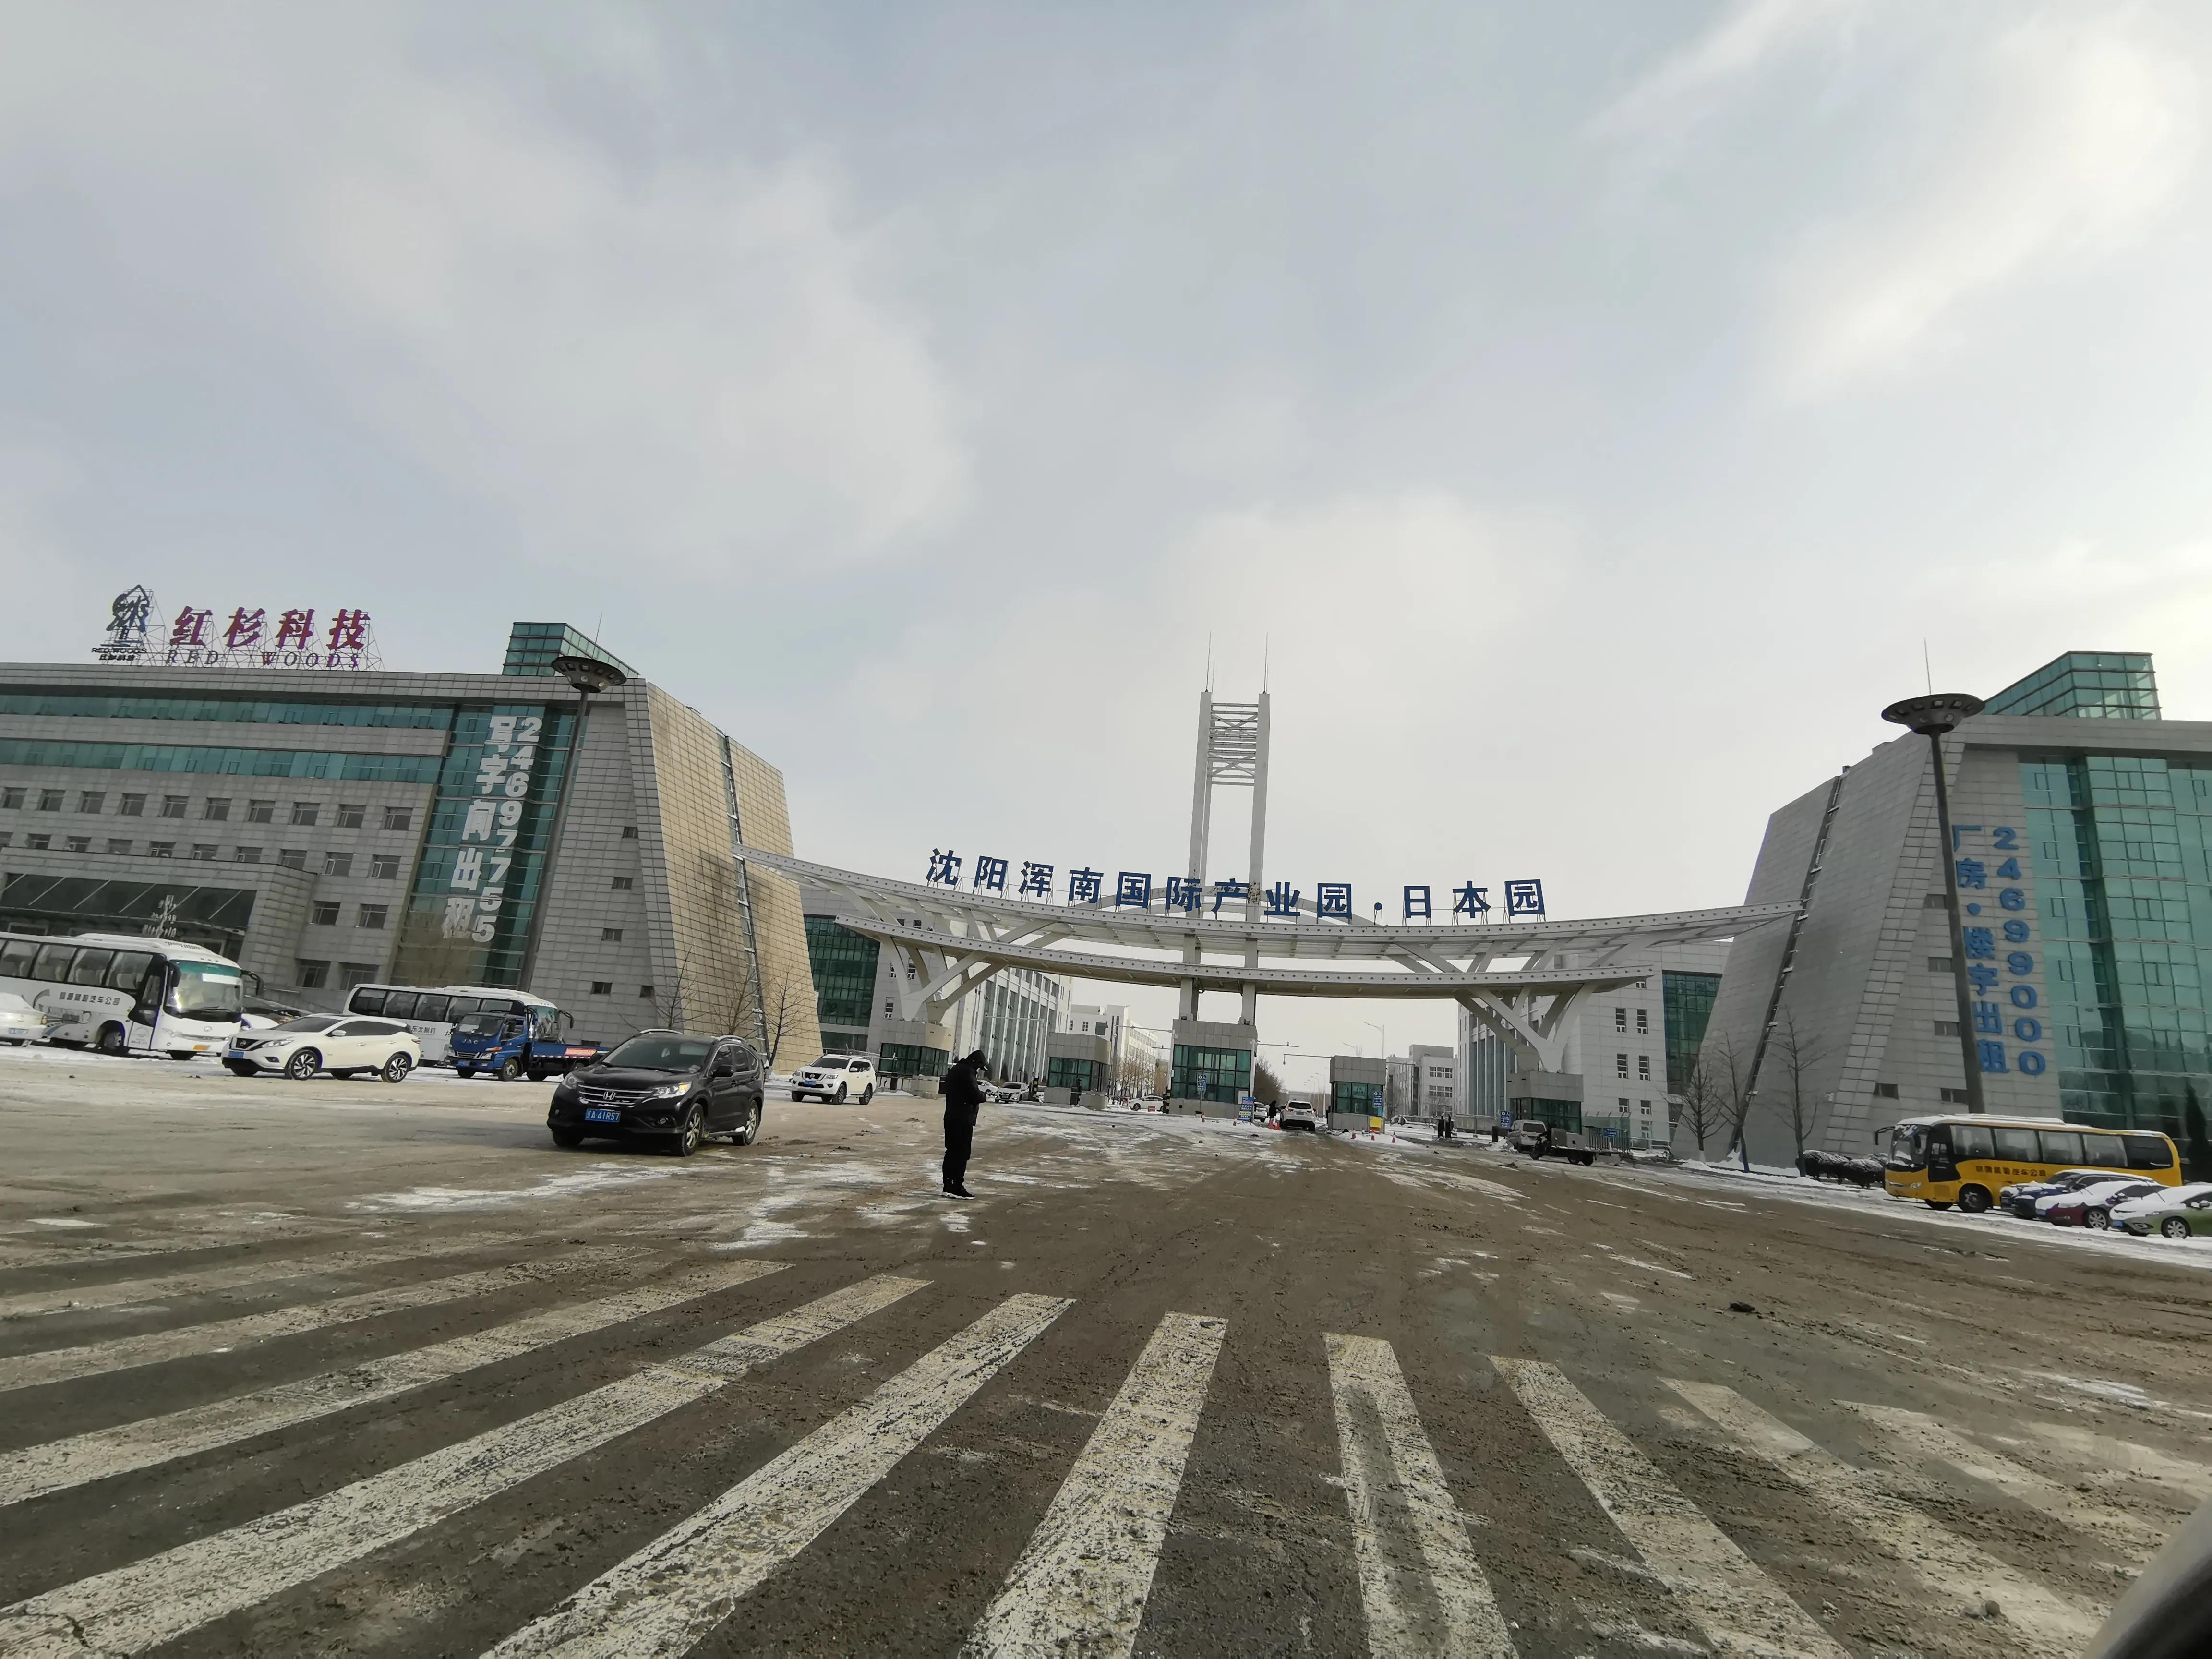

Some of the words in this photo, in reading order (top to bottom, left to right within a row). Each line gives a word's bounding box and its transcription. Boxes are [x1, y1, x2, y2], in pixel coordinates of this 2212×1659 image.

[166, 649, 218, 665] RED
[262, 651, 359, 667] WOODS
[169, 606, 371, 650] 红杉科技
[472, 717, 542, 942] 24697755
[1994, 826, 2046, 1075] 24699000
